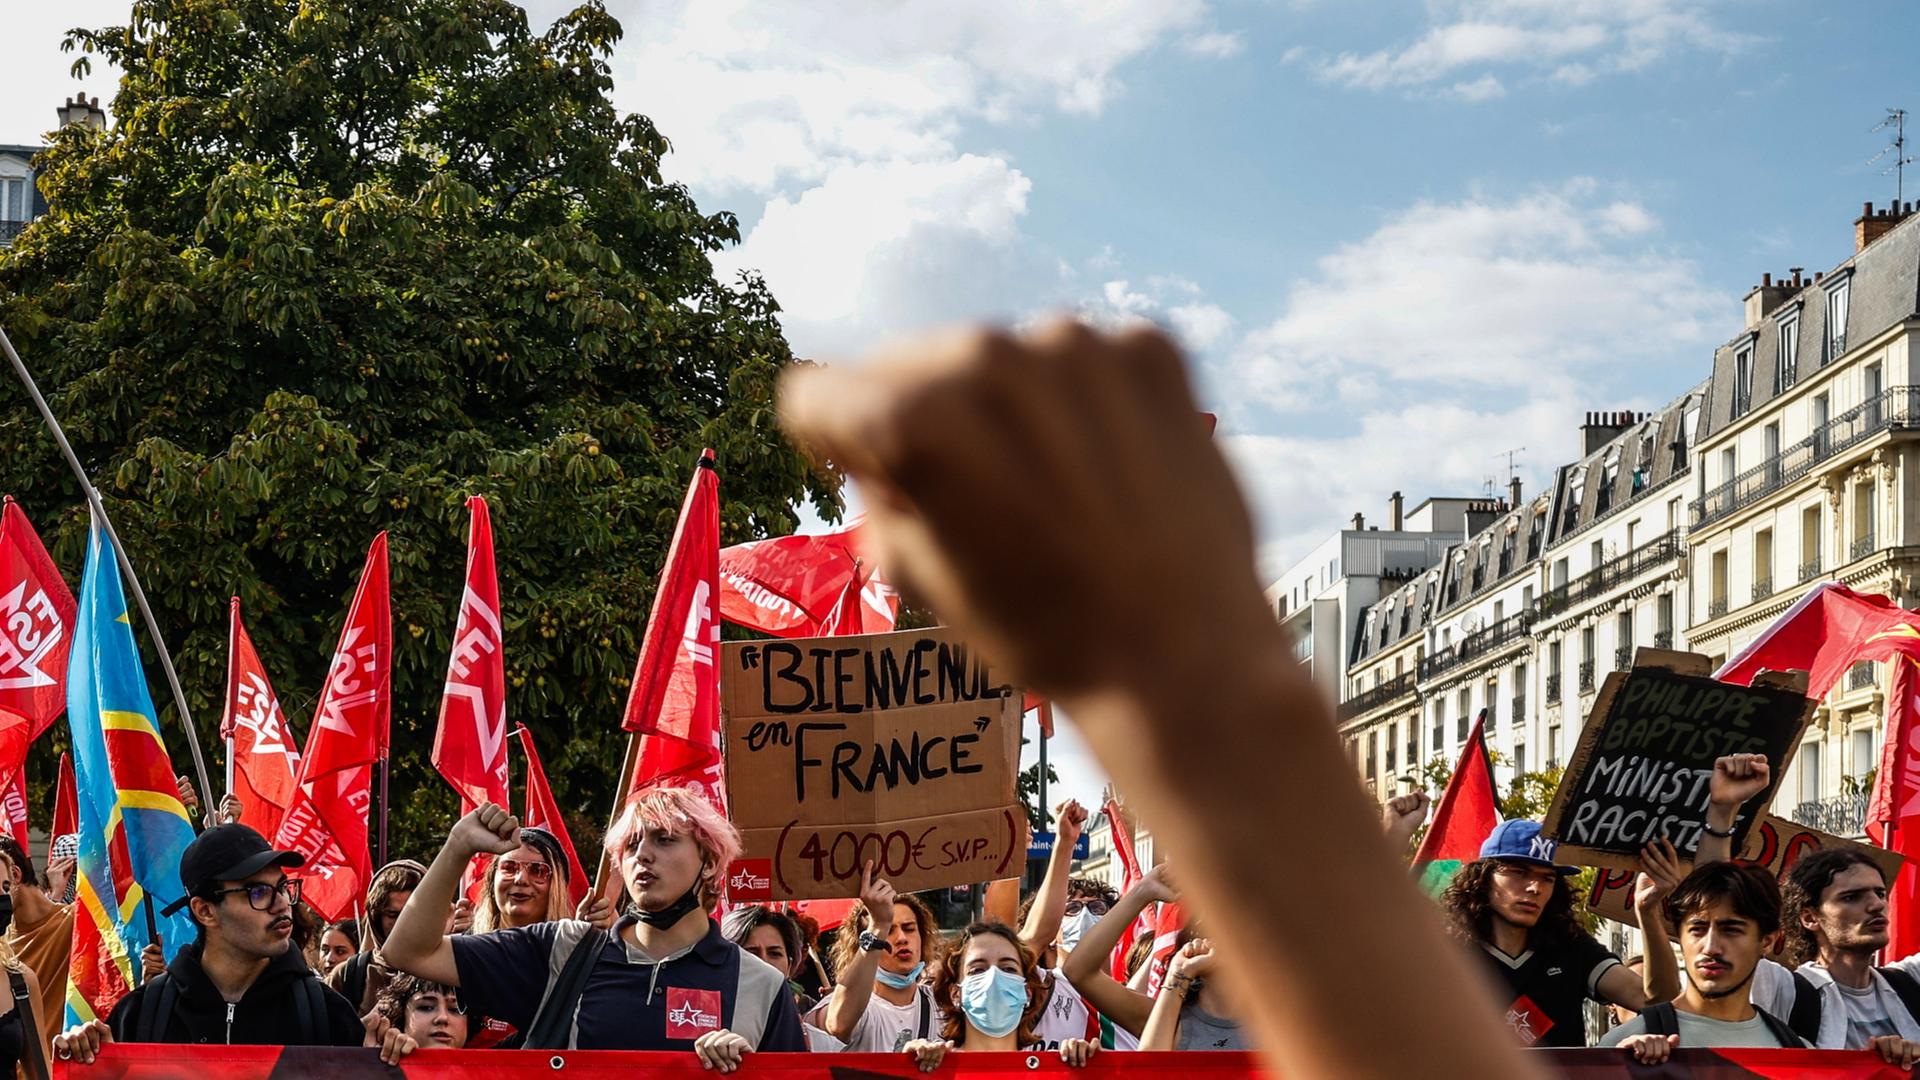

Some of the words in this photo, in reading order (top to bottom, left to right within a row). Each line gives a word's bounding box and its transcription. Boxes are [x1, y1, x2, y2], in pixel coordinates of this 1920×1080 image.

[1620, 678, 1770, 728] PHILIPPE
[741, 720, 792, 751] en
[1528, 834, 1554, 861] NY
